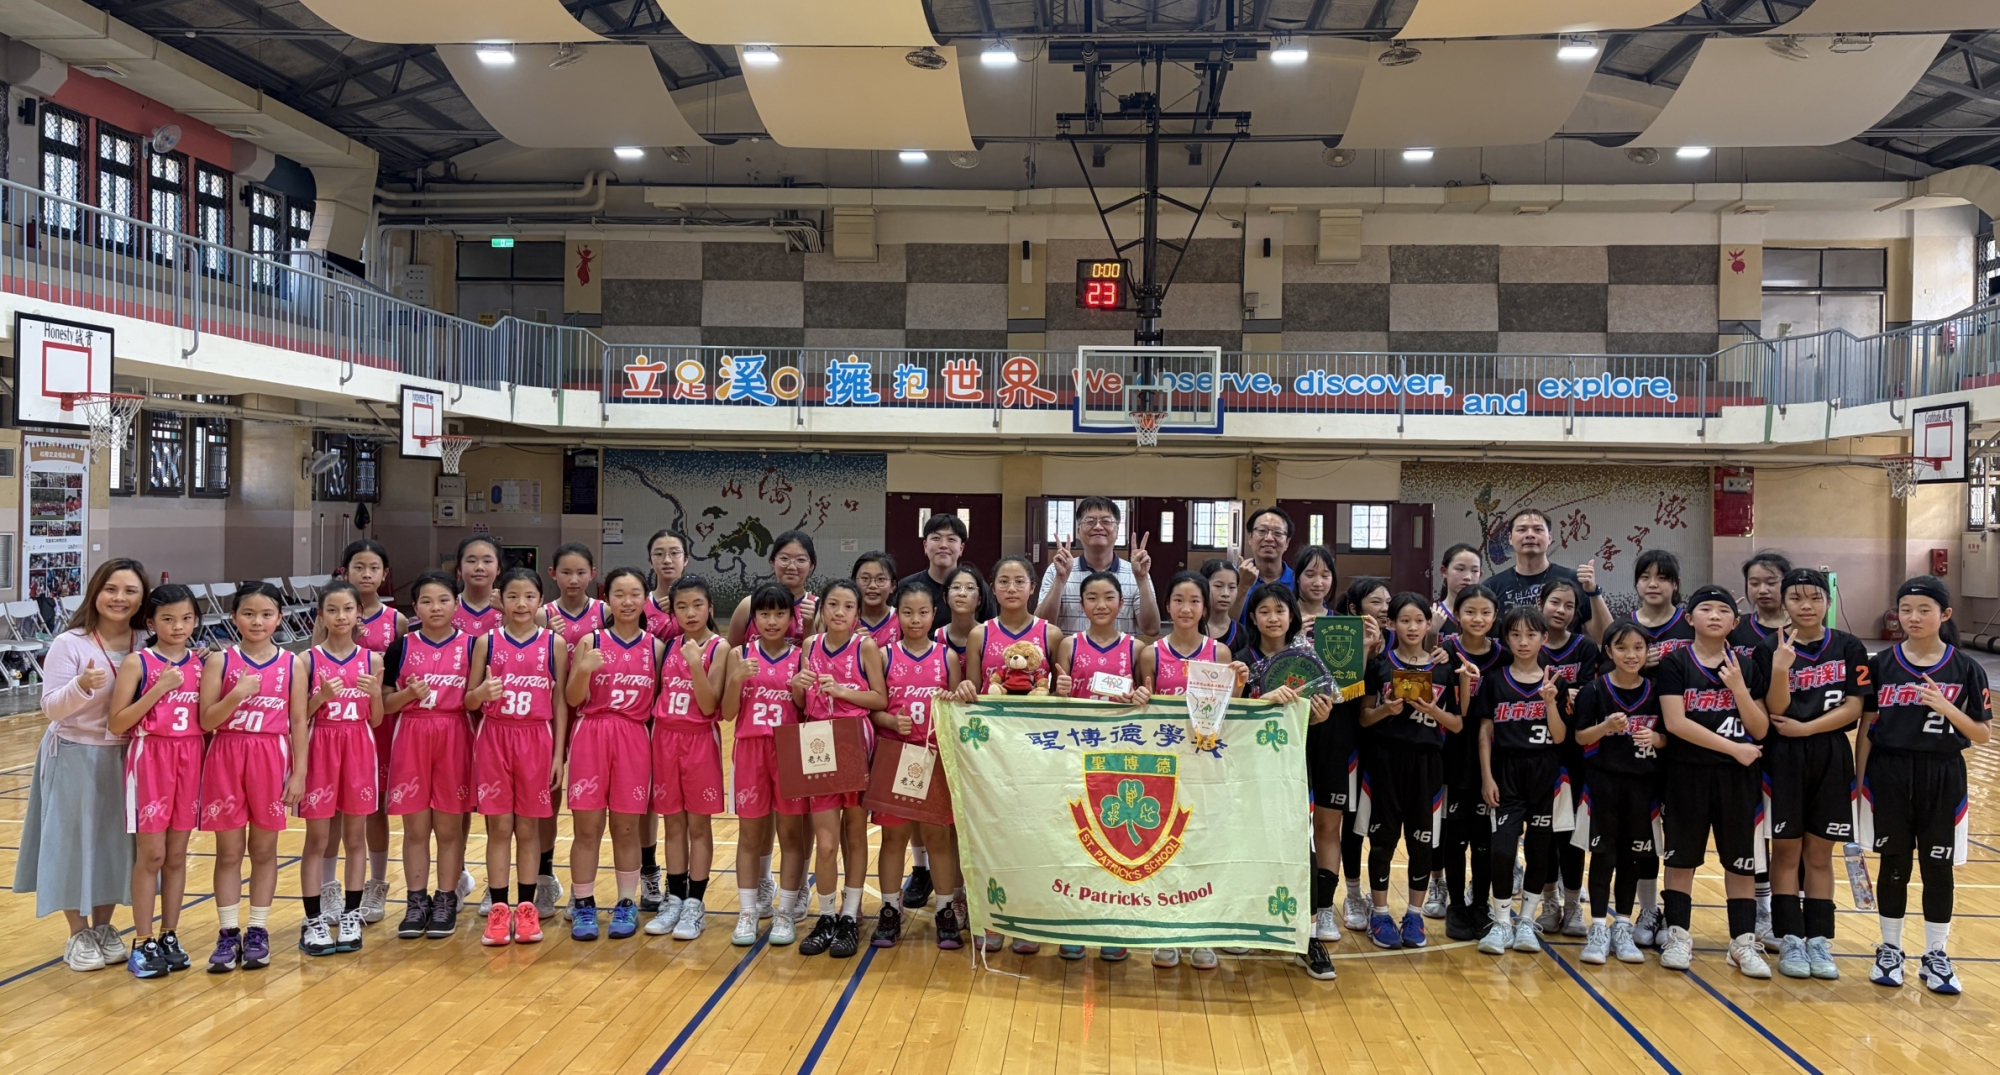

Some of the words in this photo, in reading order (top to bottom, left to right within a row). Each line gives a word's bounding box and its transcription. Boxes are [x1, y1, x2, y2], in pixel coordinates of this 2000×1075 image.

[1092, 263, 1120, 278] 0:00
[1088, 282, 1115, 305] 23
[44, 322, 74, 345] Honesty
[1072, 368, 1122, 394] We
[1293, 369, 1453, 398] discover,
[1462, 389, 1527, 415] and
[1538, 372, 1678, 403] explore.
[420, 690, 438, 711] 4
[500, 690, 532, 716] 38
[609, 689, 640, 710] 27
[668, 691, 691, 715] 19
[1823, 690, 1846, 711] 2
[172, 707, 189, 731] 3
[228, 710, 264, 733] 20
[327, 701, 359, 721] 24
[753, 702, 783, 727] 23
[910, 701, 925, 725] 8
[1716, 716, 1746, 738] 40
[1091, 755, 1171, 774] 聖博德
[1330, 792, 1347, 806] 19
[1531, 814, 1551, 828] 35
[1826, 822, 1851, 836] 22
[1413, 829, 1432, 843] 46
[1632, 839, 1653, 853] 34
[1081, 833, 1095, 850] ST.
[1094, 850, 1142, 880] PATRICK'S
[1143, 841, 1179, 873] SCHOOL
[1930, 845, 1954, 860] 21
[1733, 857, 1755, 871] 40
[1052, 878, 1075, 898] St.
[1078, 886, 1152, 907] Patrick's
[1157, 882, 1213, 907] School
